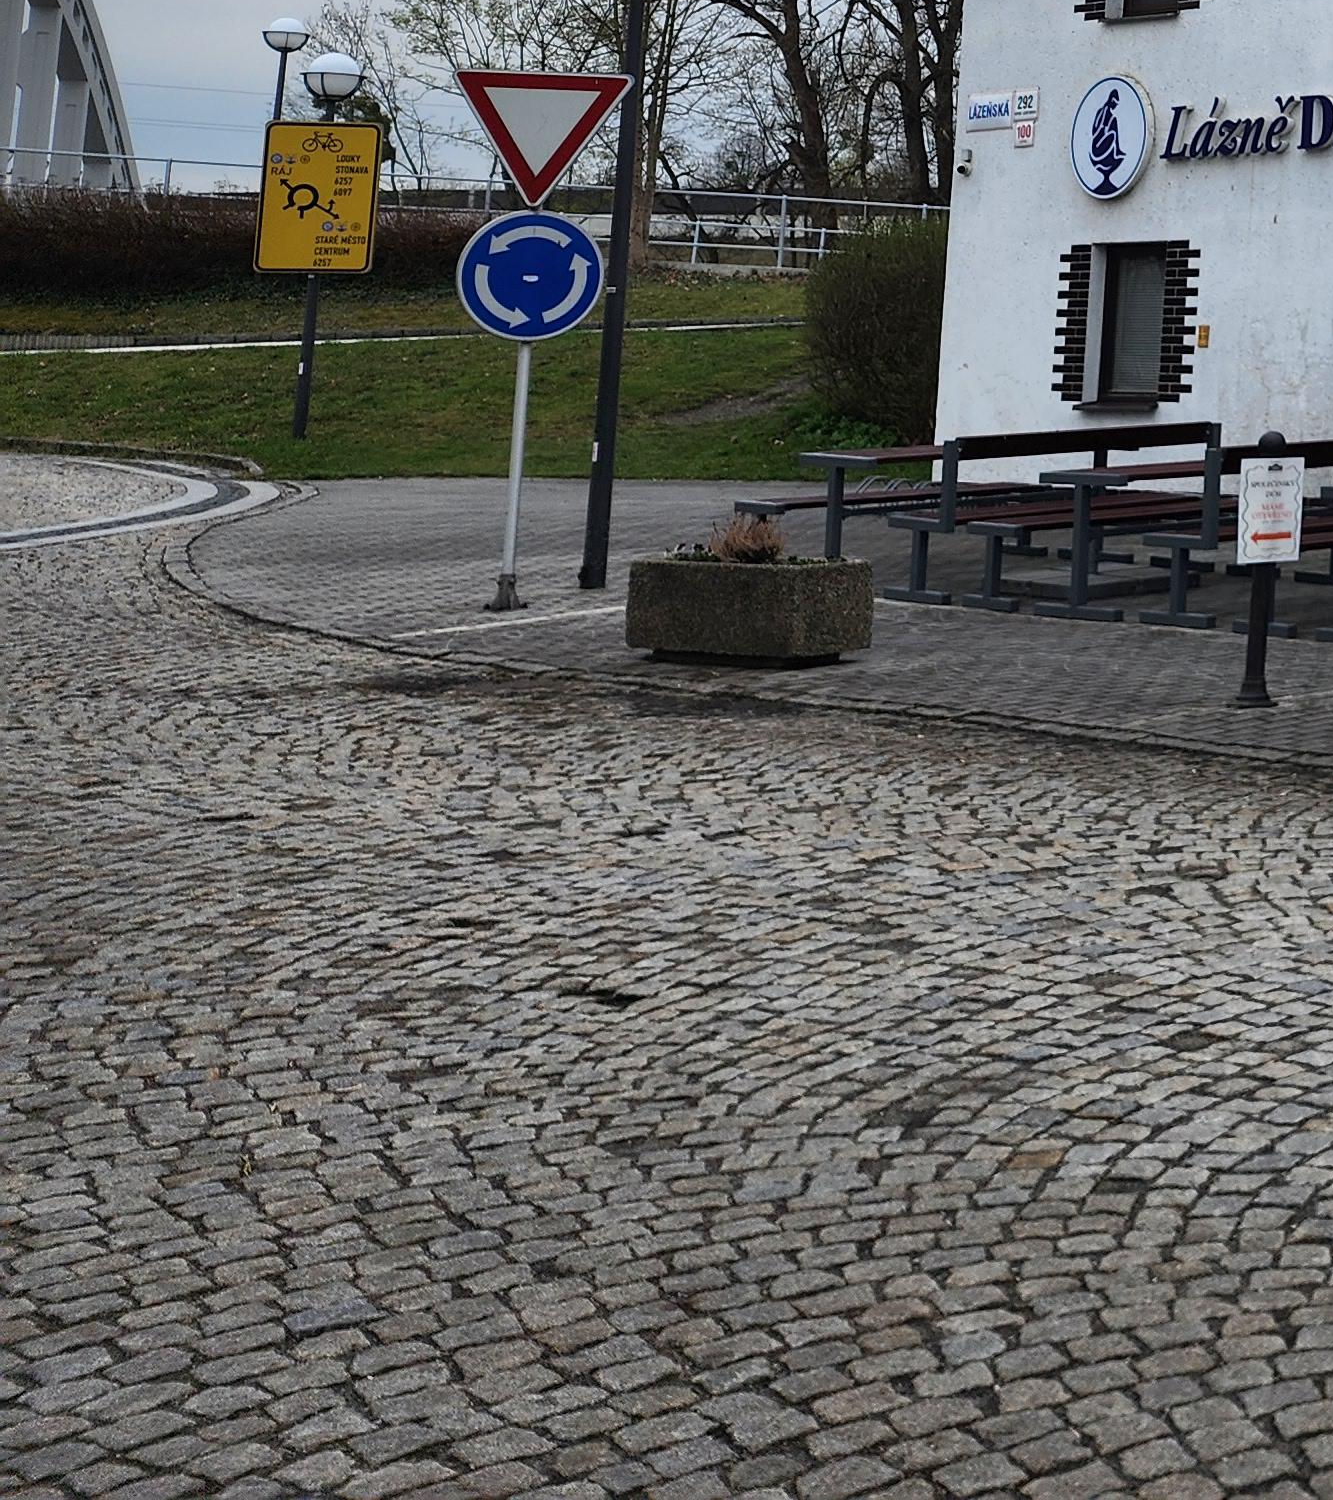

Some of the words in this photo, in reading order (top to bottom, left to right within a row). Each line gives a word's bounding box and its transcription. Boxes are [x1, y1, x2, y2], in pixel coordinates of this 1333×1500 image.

[1017, 94, 1034, 110] 292
[968, 99, 1010, 120] LÁZEŇSKÁ
[1017, 124, 1032, 139] 100
[1159, 95, 1296, 160] Lázně
[271, 165, 292, 175] RÁJ
[335, 165, 369, 174] STONAVA
[334, 177, 353, 185] 6257
[333, 188, 352, 196] 6097
[315, 235, 339, 244] STARÉ
[341, 235, 366, 244] MĚSTO
[314, 247, 350, 255] CENTRUM
[312, 258, 332, 267] 6257
